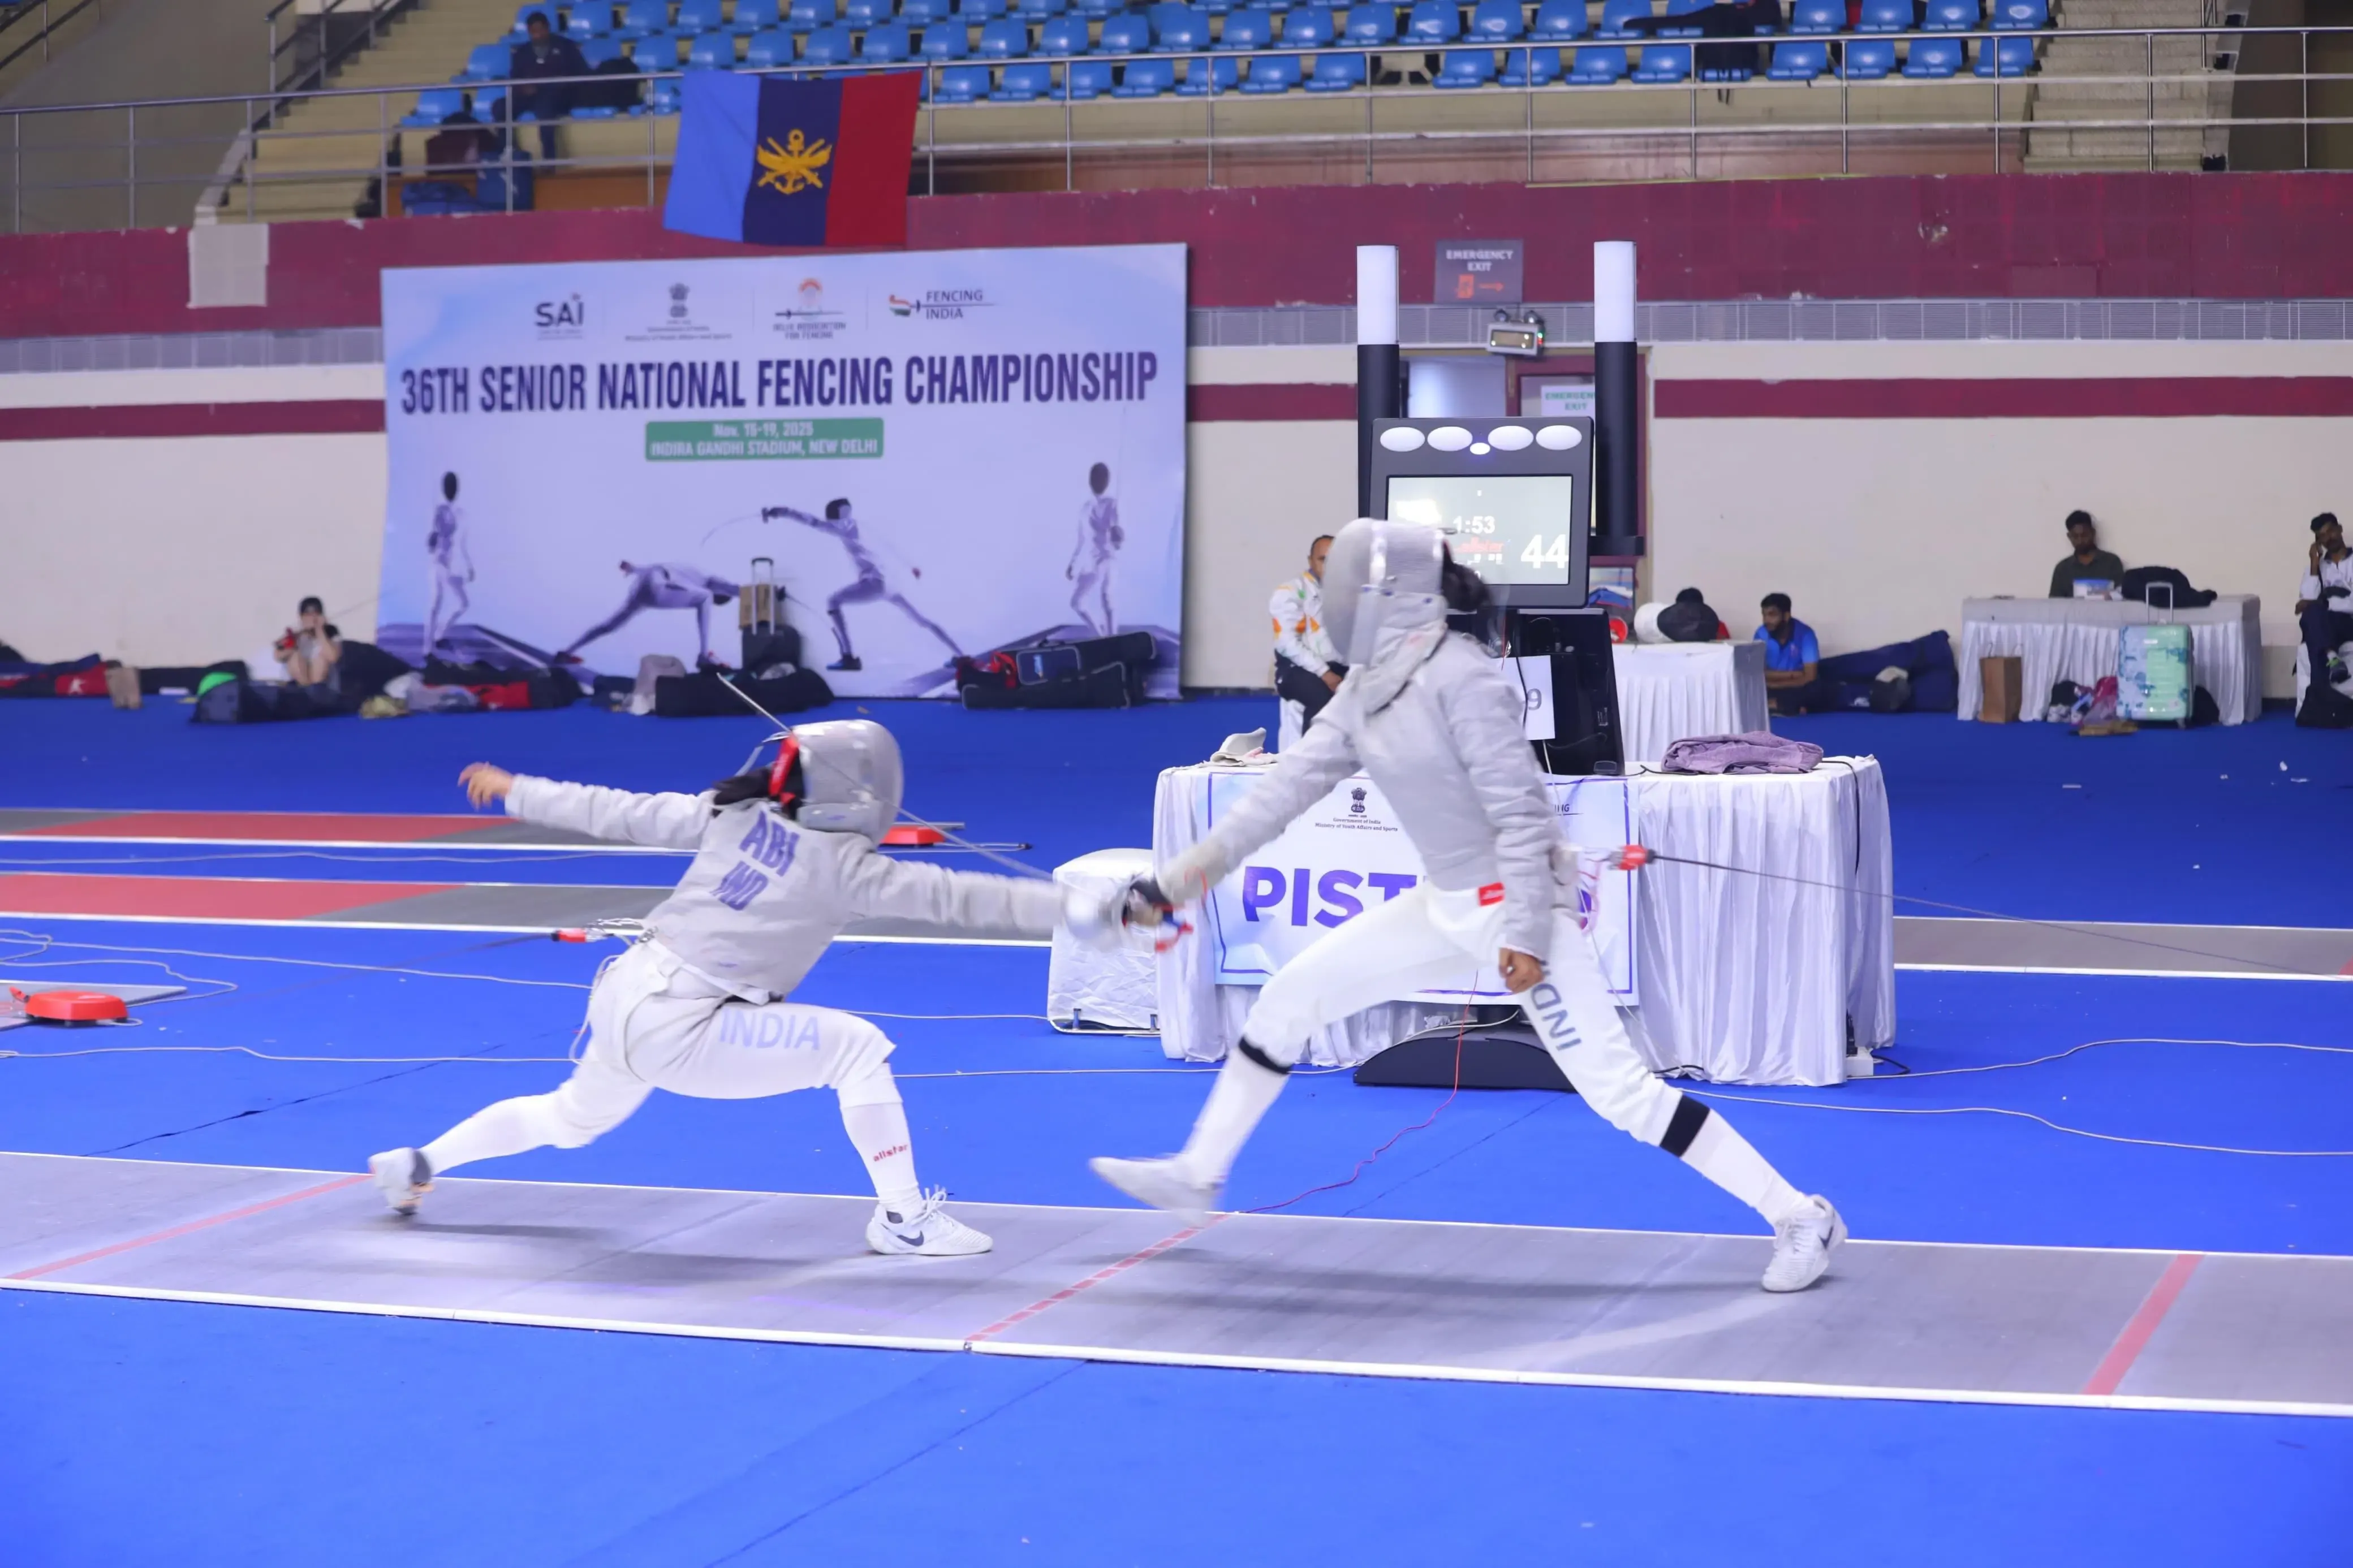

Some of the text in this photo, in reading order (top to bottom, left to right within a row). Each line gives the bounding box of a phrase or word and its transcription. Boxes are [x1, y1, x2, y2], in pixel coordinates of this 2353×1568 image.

[1445, 249, 1514, 260] EMERGENCY
[1467, 261, 1493, 271] EXIT
[925, 290, 984, 303] FENCING
[925, 307, 964, 319] INDIA
[400, 351, 1158, 414] 36TH SENIOR NATIONAL FENCING CHAMPIONSHIP
[782, 421, 814, 437] 2025
[650, 438, 878, 457] INDIRA GANDHI STADIUM, NEW DELHI
[1453, 515, 1495, 534] 1:53
[1520, 534, 1569, 569] 44
[1243, 866, 1420, 928] PIST
[718, 1007, 820, 1051] INDIA
[873, 1144, 908, 1162] allstar
